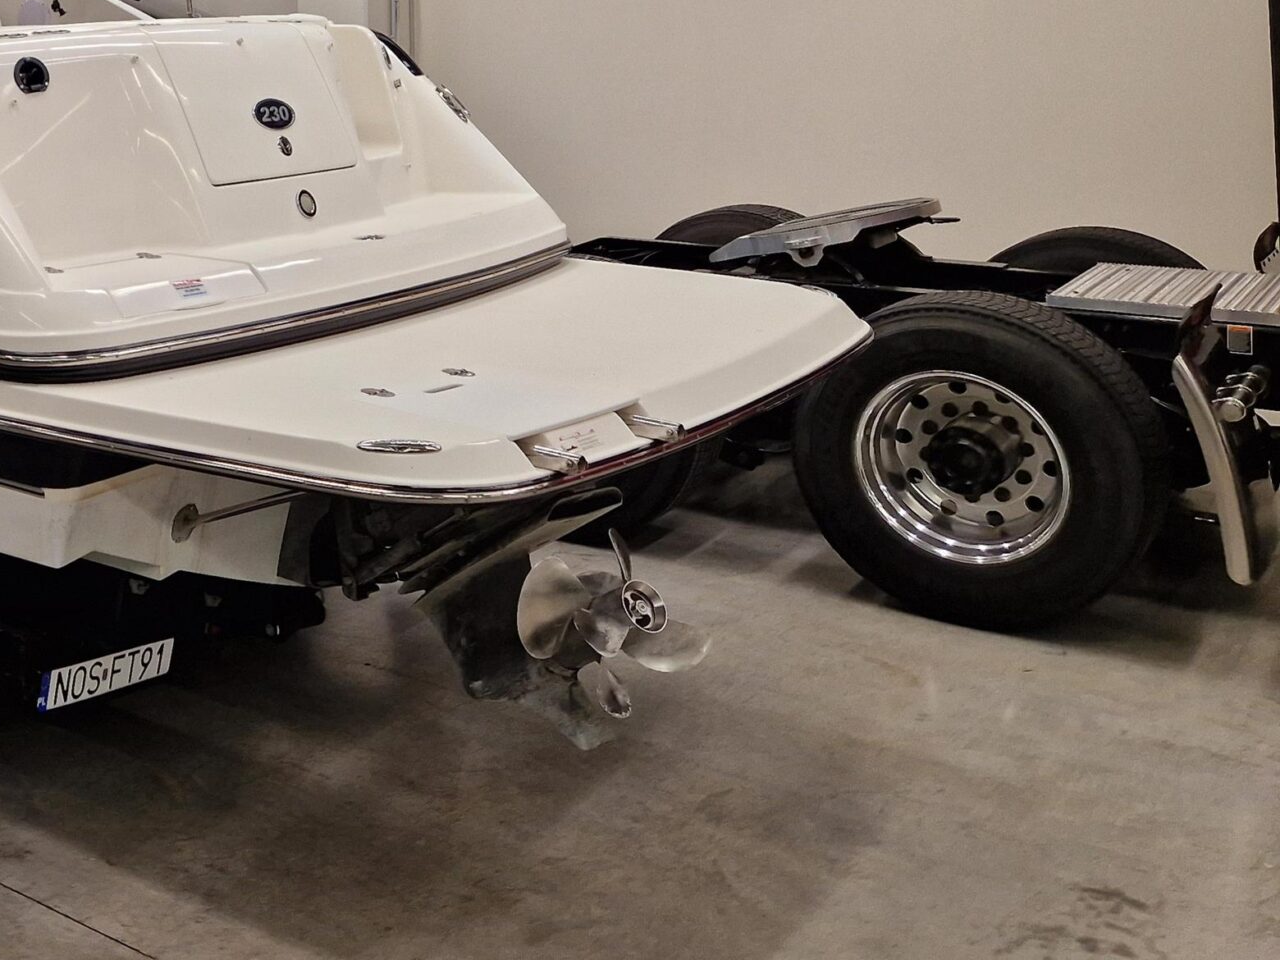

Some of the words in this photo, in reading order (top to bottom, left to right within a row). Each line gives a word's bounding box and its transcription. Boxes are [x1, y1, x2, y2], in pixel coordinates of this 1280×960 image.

[259, 105, 290, 123] 230
[53, 661, 104, 706] NOS
[109, 643, 165, 690] FT91
